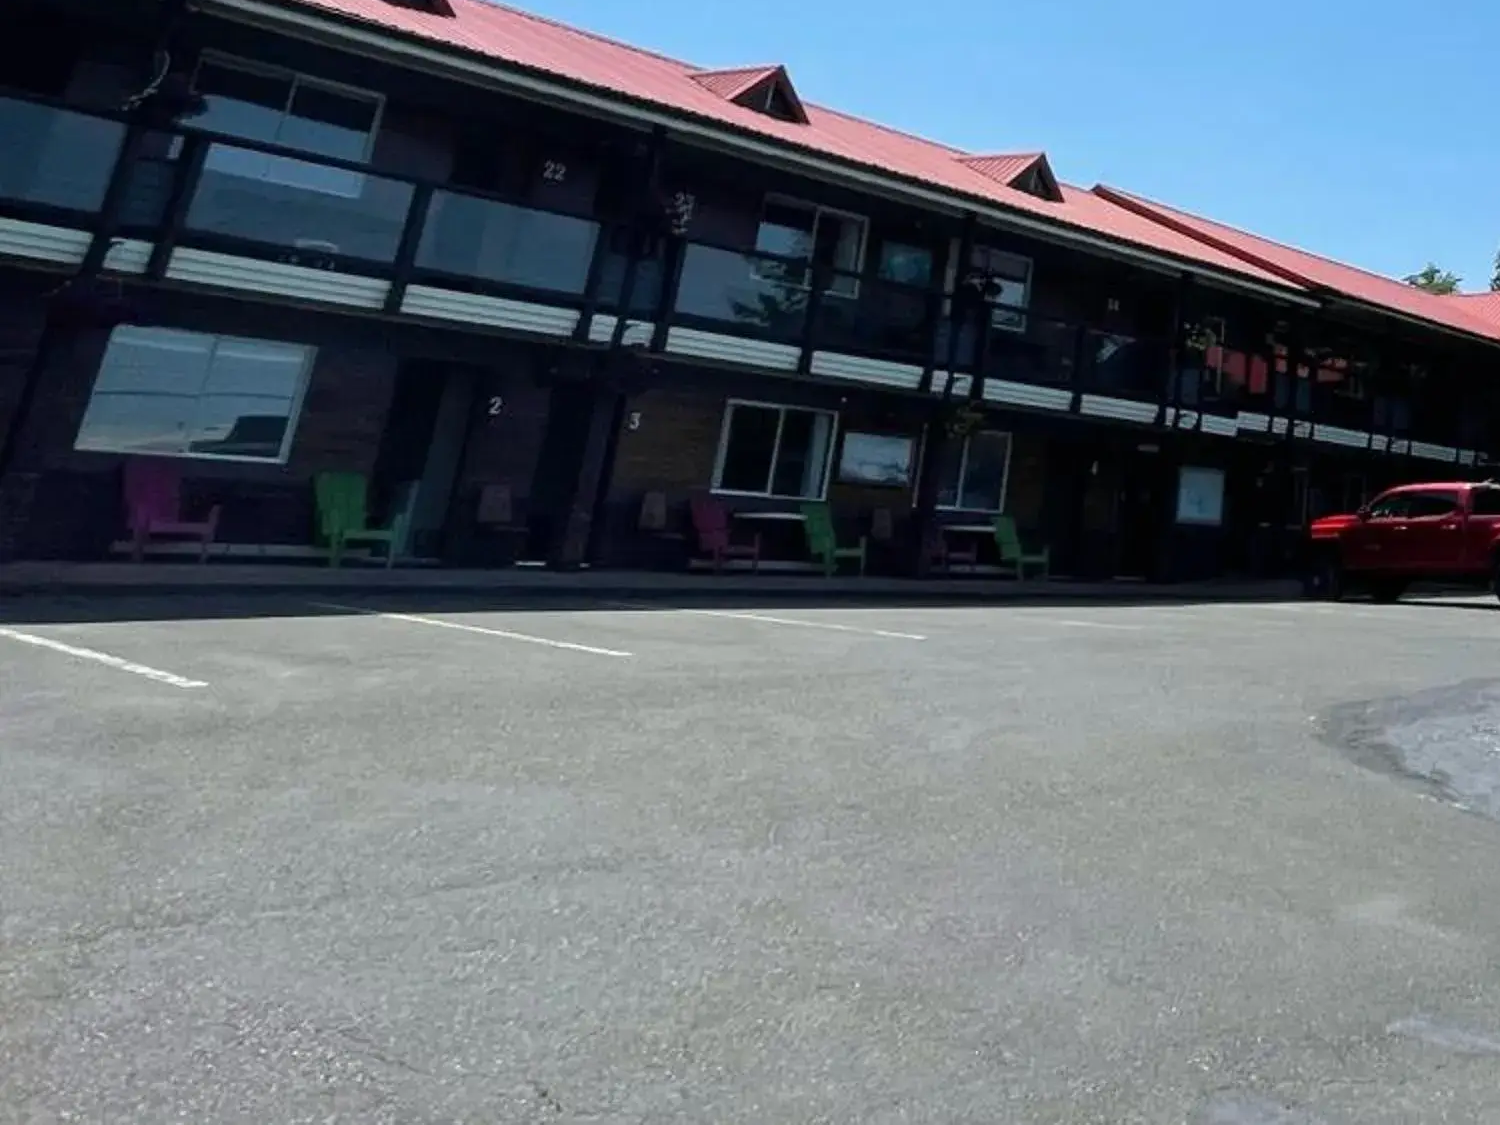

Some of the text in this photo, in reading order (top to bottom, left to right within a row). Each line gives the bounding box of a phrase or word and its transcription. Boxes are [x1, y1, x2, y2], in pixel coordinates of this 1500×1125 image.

[543, 160, 566, 181] 22
[488, 396, 503, 415] 2
[629, 411, 642, 429] 3
